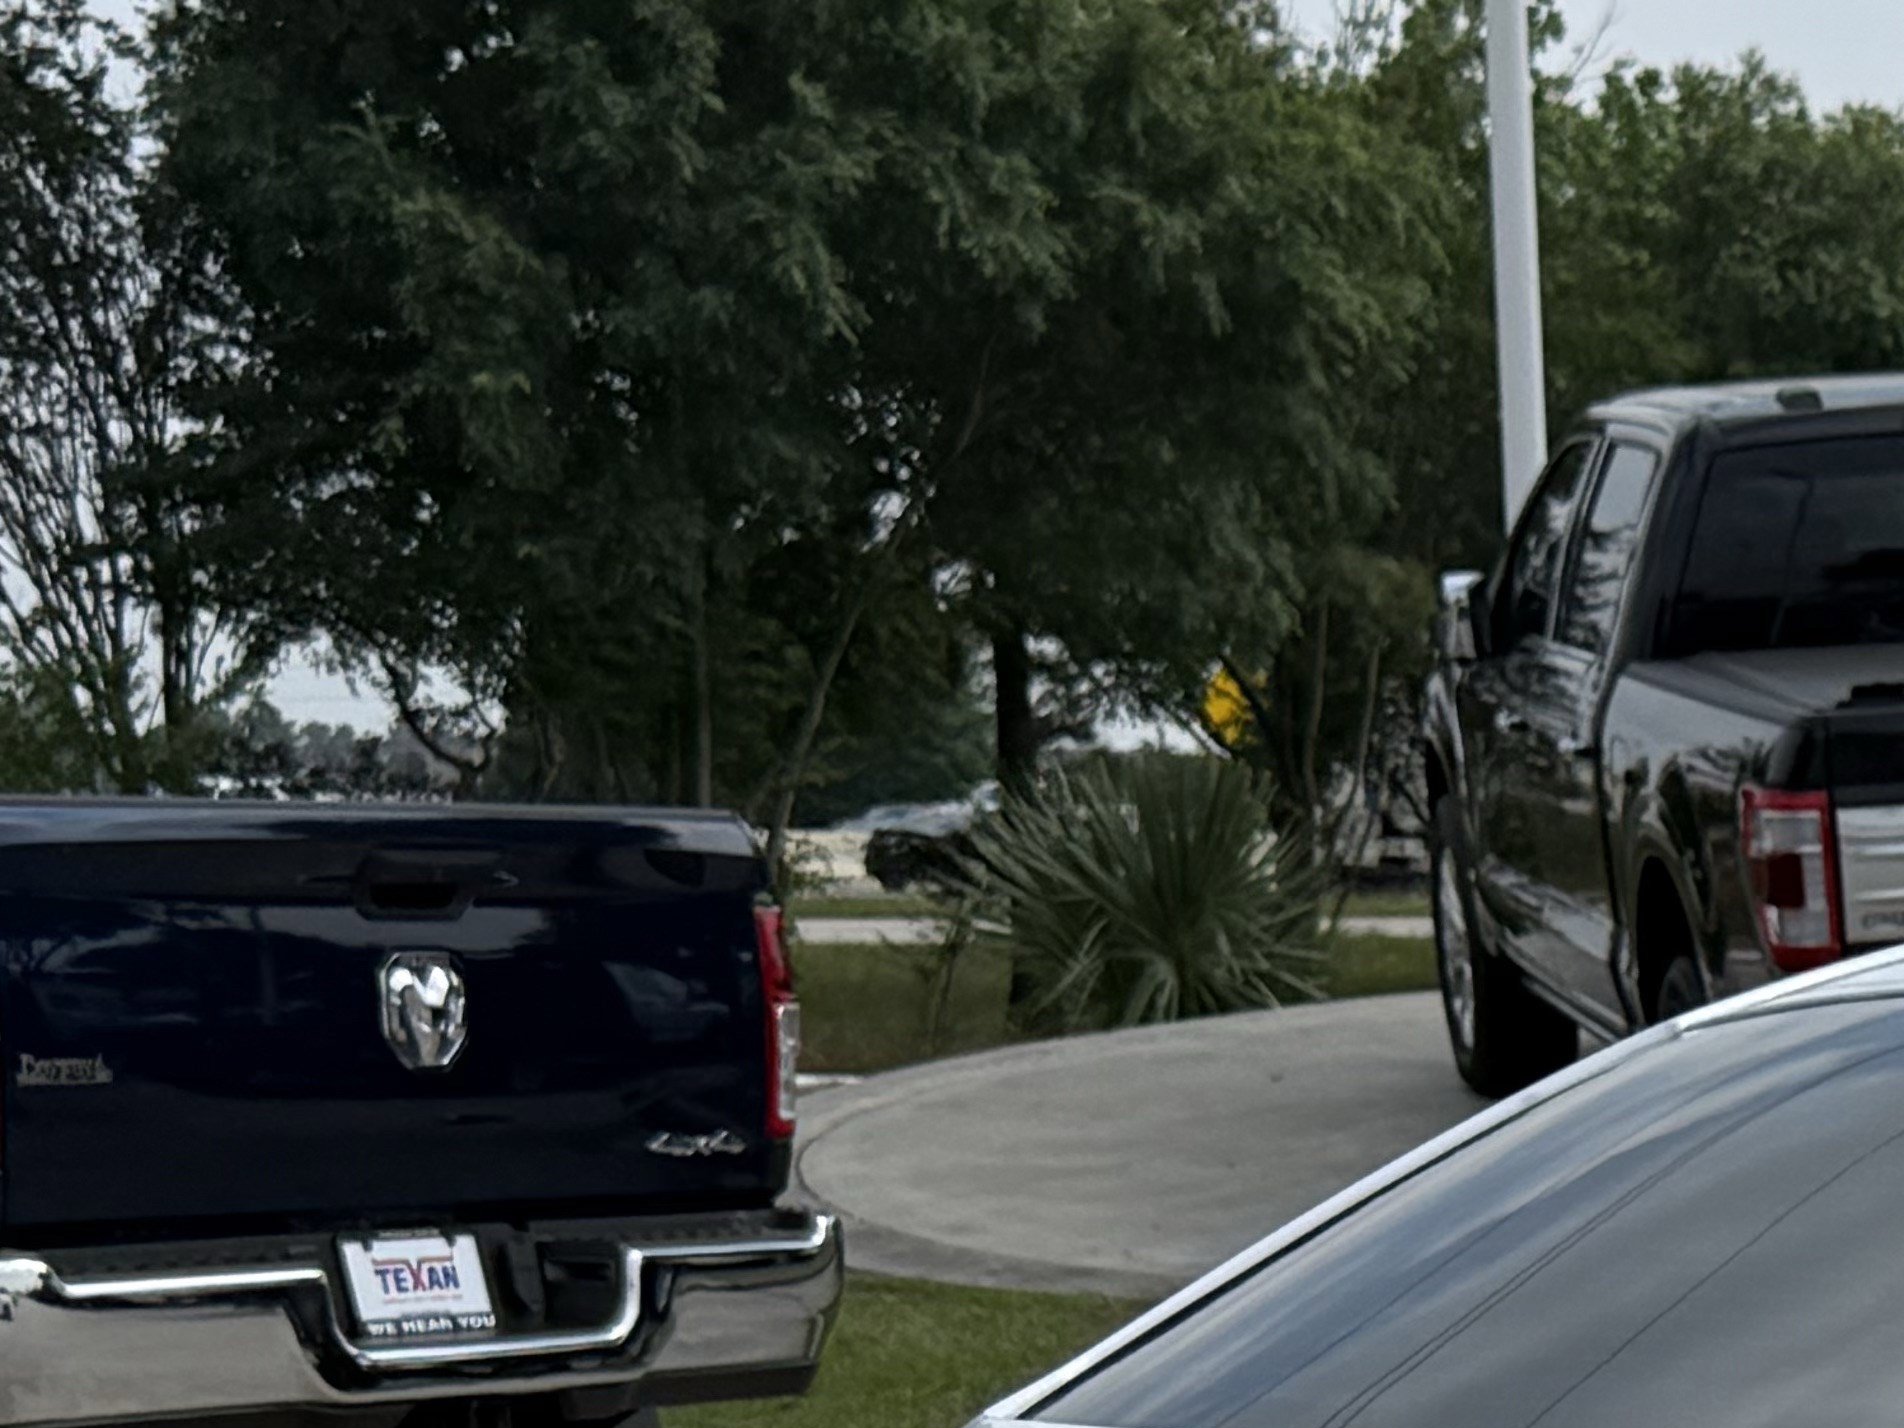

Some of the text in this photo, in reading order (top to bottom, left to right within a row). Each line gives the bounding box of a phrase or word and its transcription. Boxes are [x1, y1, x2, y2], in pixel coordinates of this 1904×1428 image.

[374, 1258, 460, 1295] TEXAN
[367, 1313, 497, 1336] WE HEAR YOU
